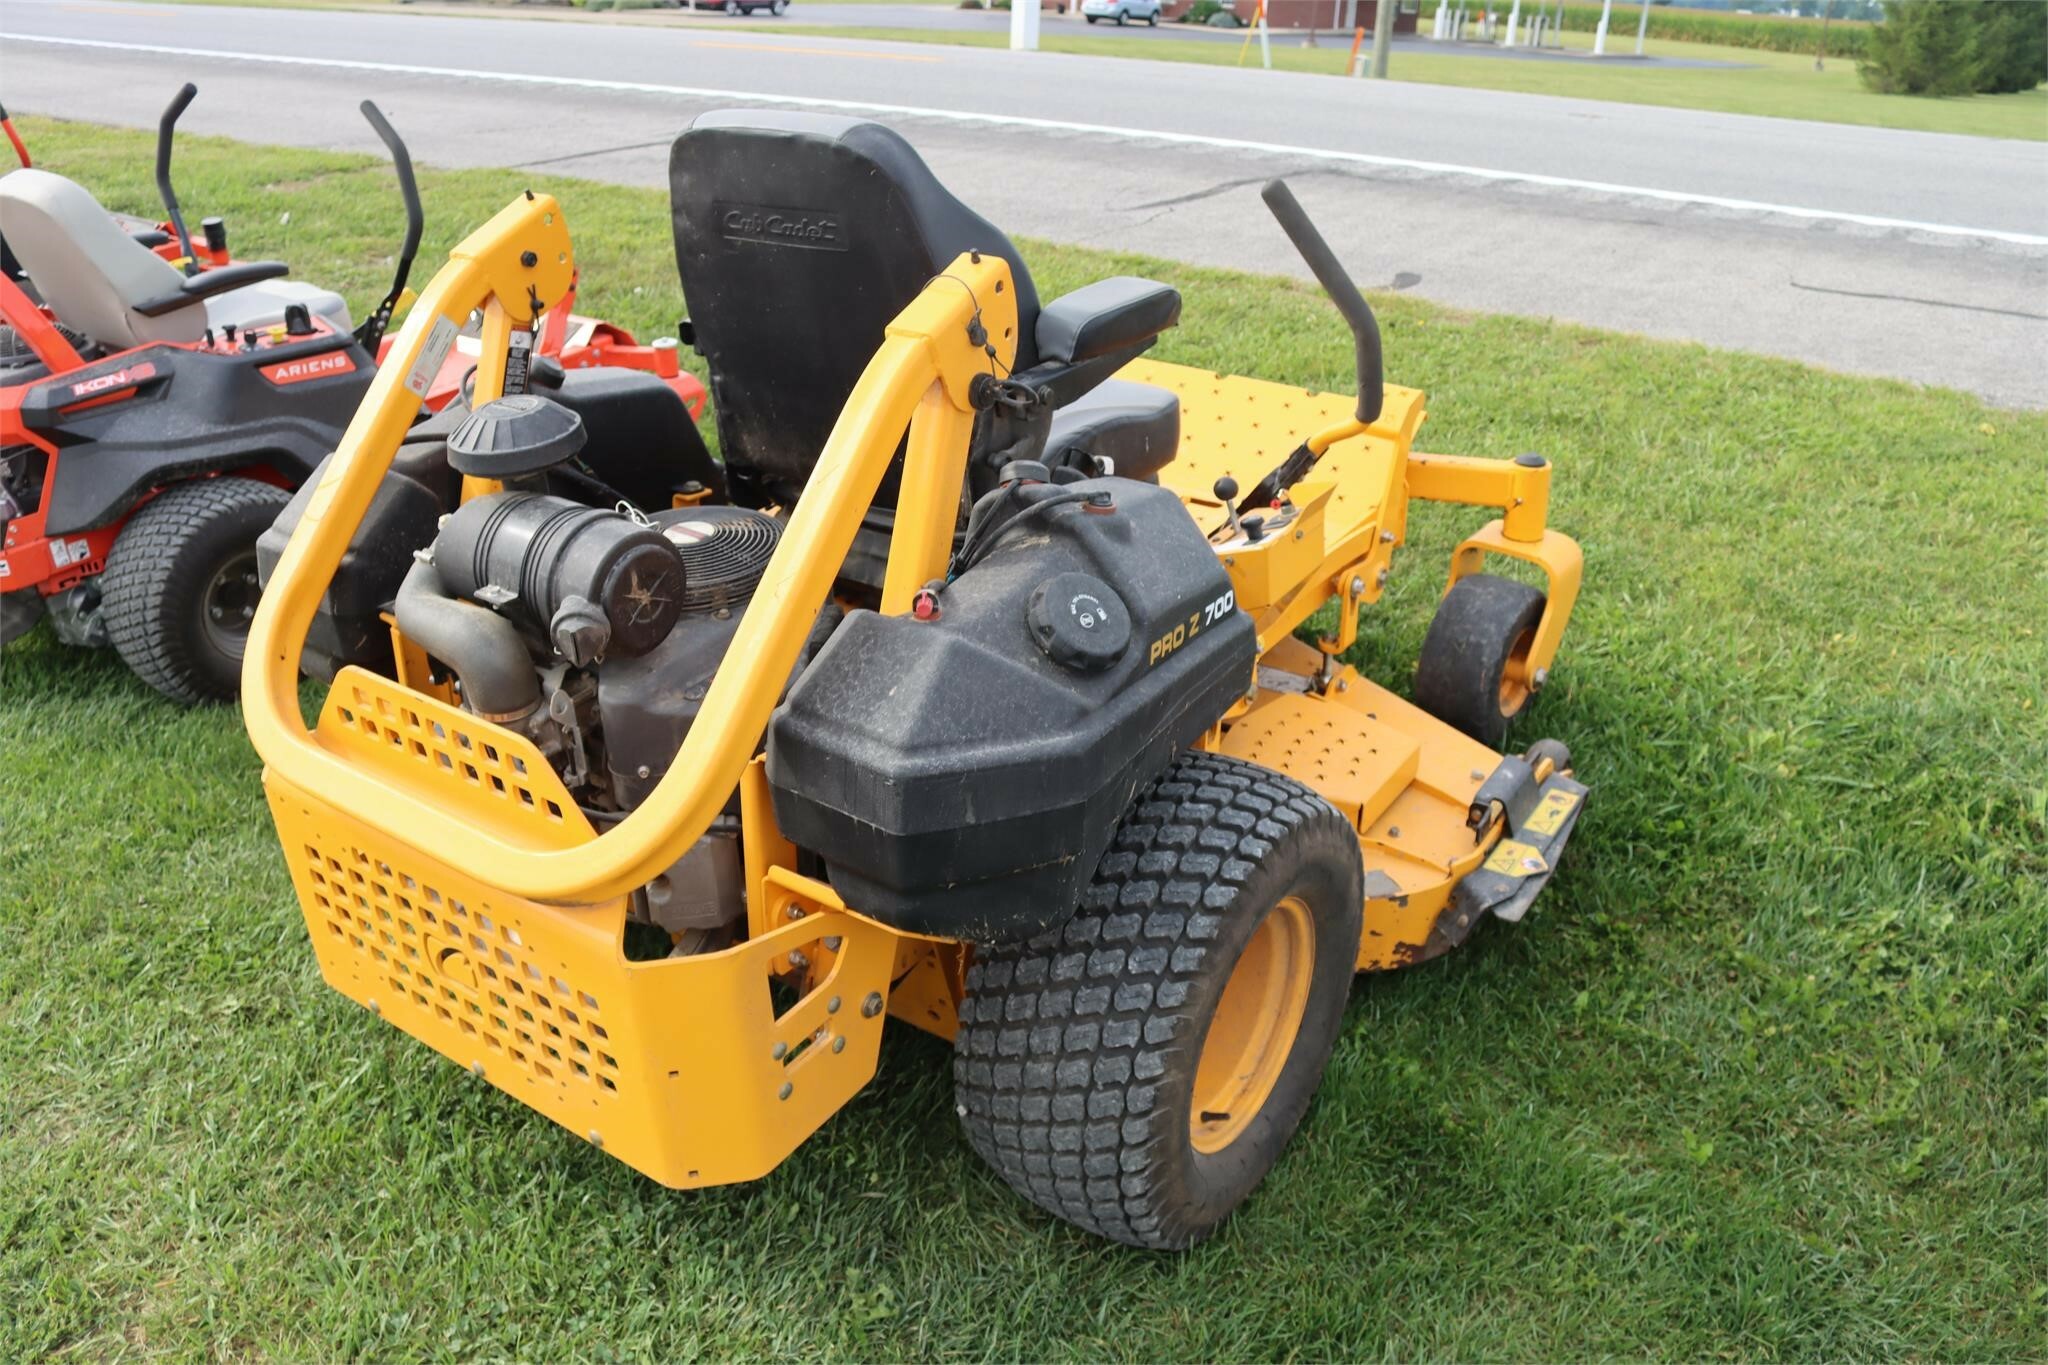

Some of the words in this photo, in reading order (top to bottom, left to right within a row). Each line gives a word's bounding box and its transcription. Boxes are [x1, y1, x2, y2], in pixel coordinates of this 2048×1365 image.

[723, 210, 763, 232] Cub
[275, 356, 346, 380] ARIENS
[1150, 624, 1185, 666] PRO
[1189, 612, 1201, 638] Z
[1205, 589, 1234, 627] 700
